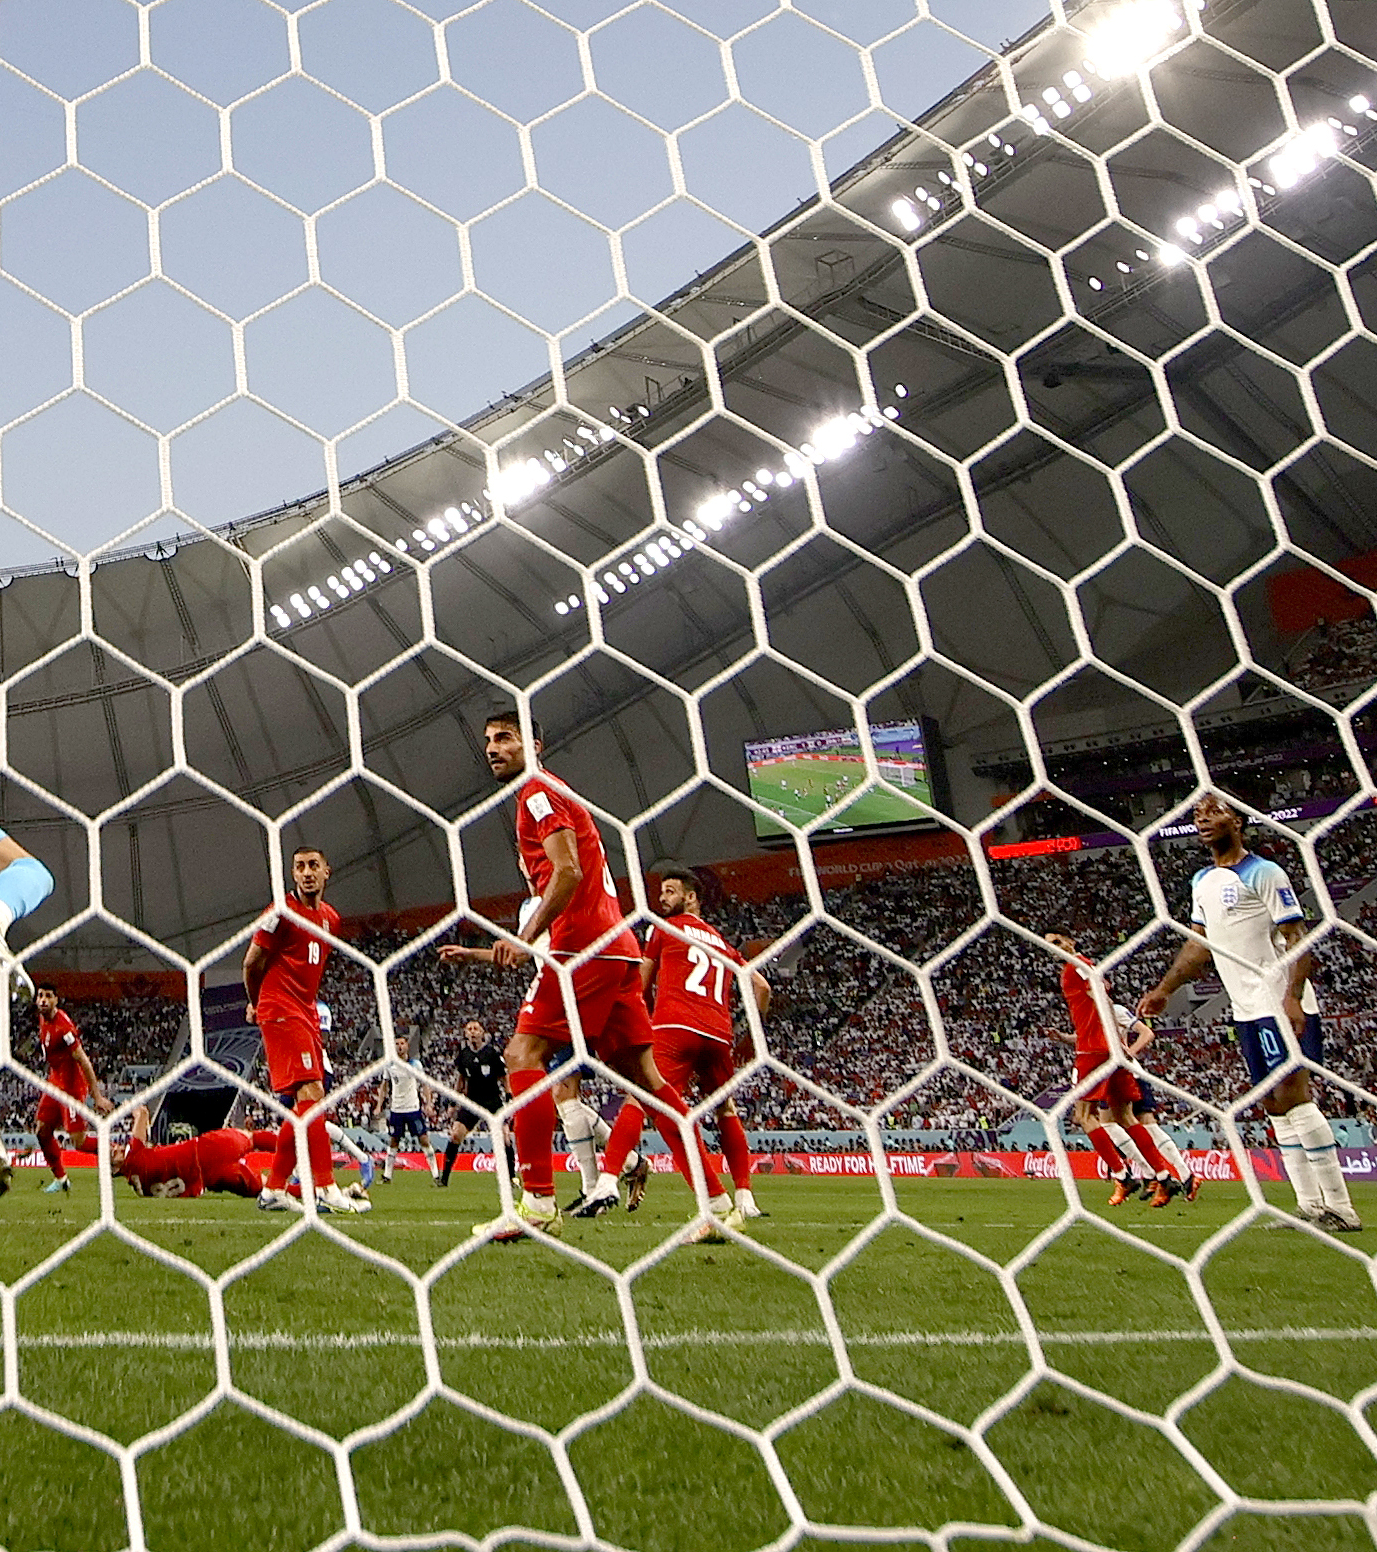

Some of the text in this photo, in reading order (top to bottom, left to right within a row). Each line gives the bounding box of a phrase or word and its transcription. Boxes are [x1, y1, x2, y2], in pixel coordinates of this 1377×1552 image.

[1159, 826, 1179, 838] FIFA
[308, 940, 320, 965] 19
[685, 945, 725, 1006] 21
[1258, 1027, 1281, 1058] 10
[809, 1155, 843, 1174] READY
[844, 1155, 868, 1174] FOR
